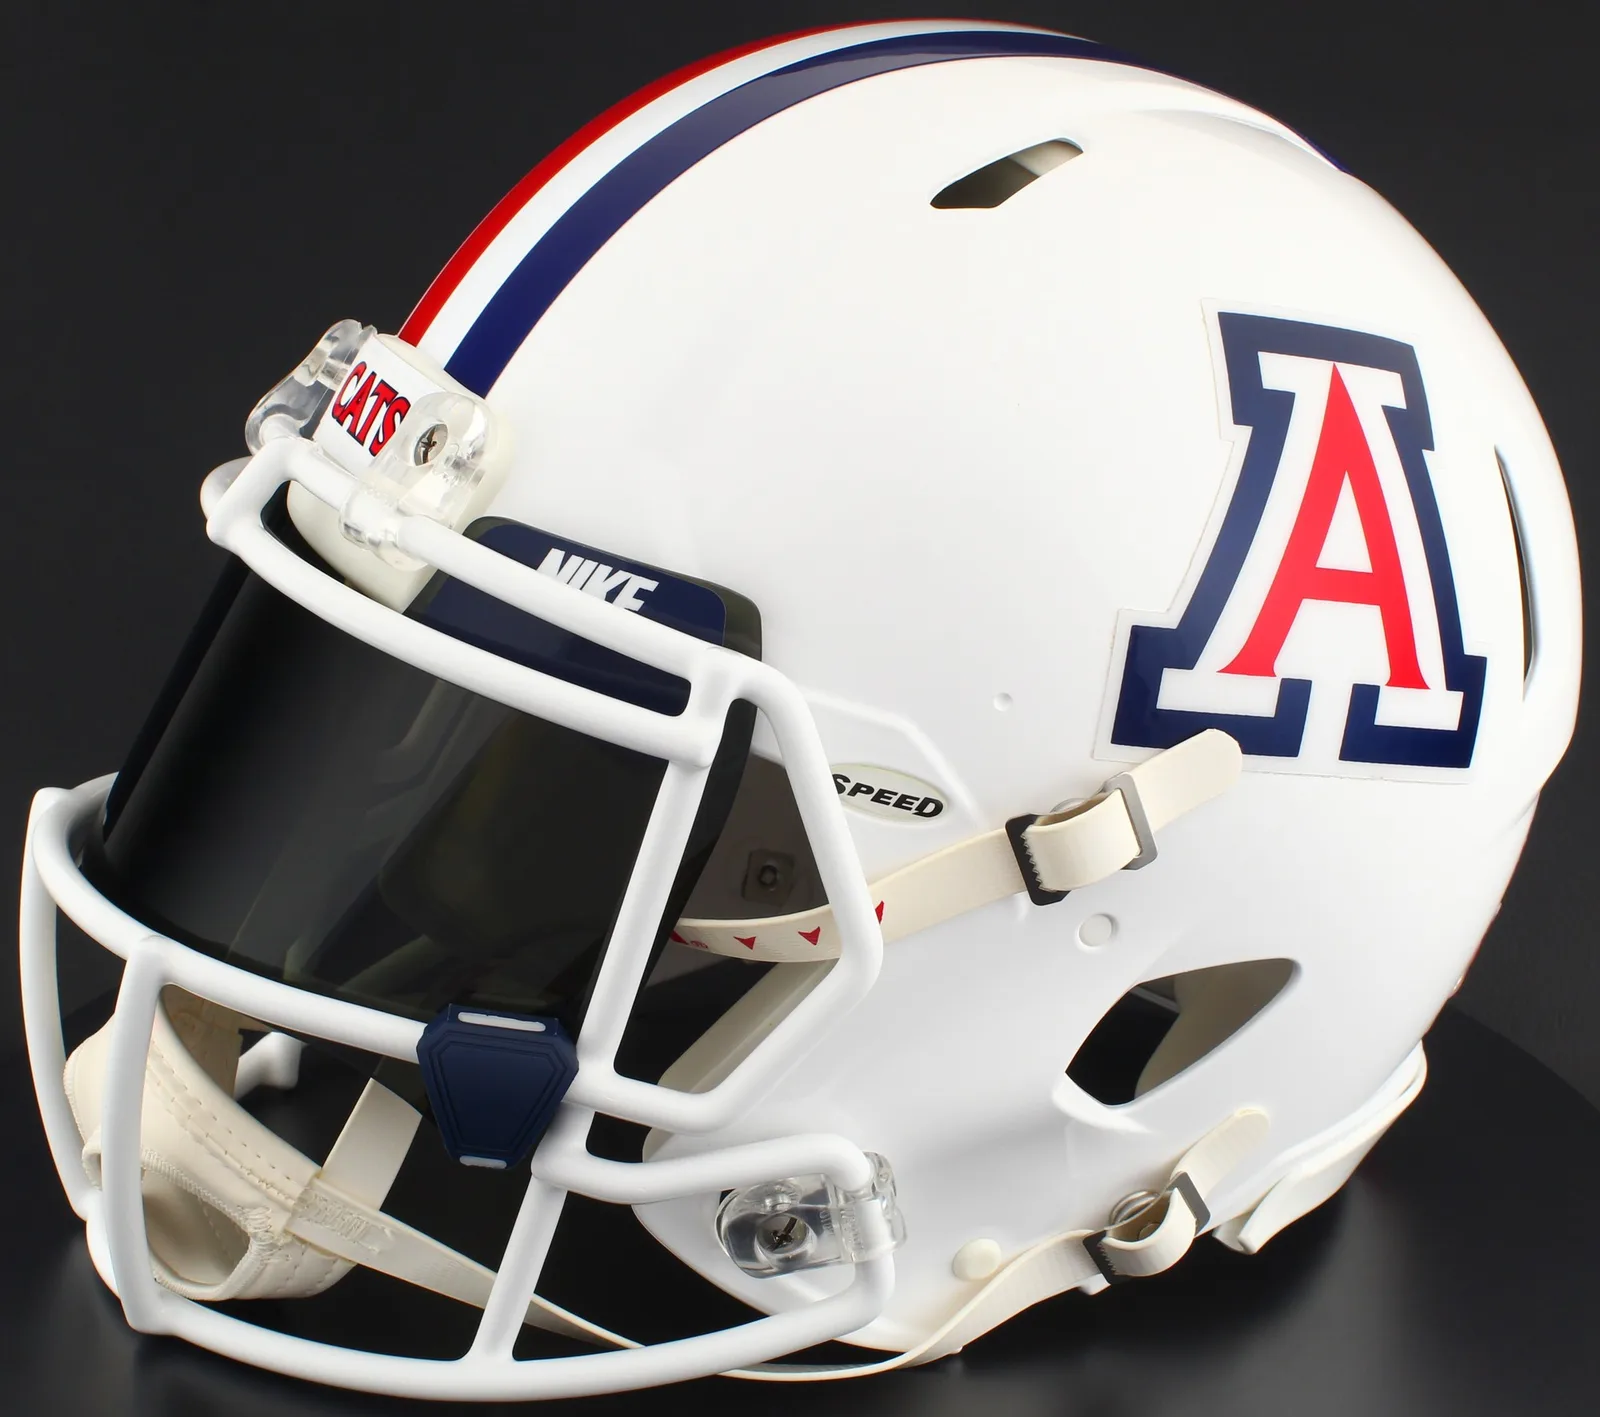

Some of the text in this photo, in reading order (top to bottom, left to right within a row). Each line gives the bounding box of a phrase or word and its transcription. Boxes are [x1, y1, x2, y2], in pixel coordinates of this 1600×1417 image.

[332, 361, 411, 457] CATS
[536, 547, 660, 612] NIKE
[1111, 311, 1488, 769] A
[832, 773, 944, 818] SPEED
